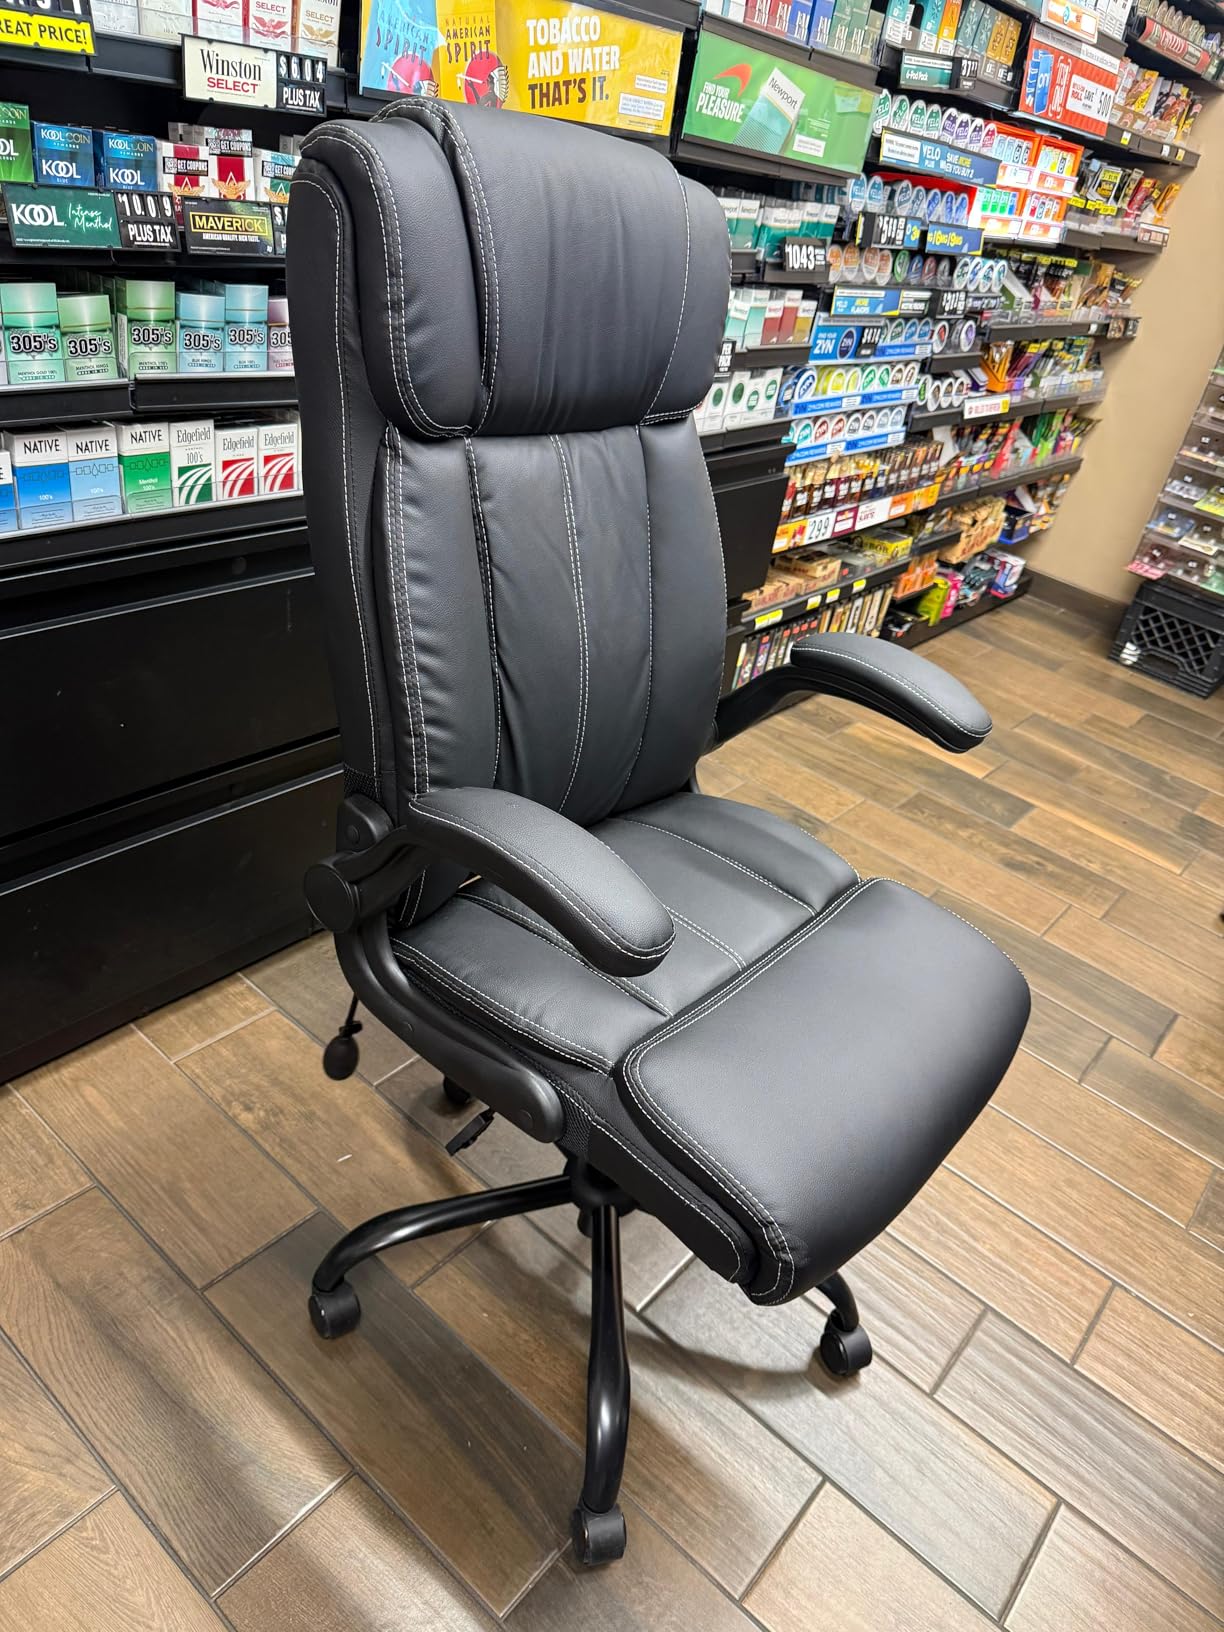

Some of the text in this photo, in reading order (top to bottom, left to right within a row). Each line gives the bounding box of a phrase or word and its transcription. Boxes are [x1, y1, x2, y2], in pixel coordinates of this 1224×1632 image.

[255, 1, 287, 14] SELECT
[305, 10, 335, 24] SELECT
[445, 15, 491, 26] NATURAL
[38, 24, 88, 45] PRICE!
[446, 25, 491, 40] AMERICAN
[526, 16, 601, 46] TOBACCO
[376, 26, 427, 66] SPIRIT
[446, 40, 491, 64] SPIRIT
[200, 49, 262, 81] Winston
[528, 45, 621, 79] AND WATER
[207, 77, 259, 94] SELECT
[528, 77, 587, 110] THAT'S
[592, 75, 609, 102] IT.
[768, 77, 798, 110] Newport
[283, 87, 321, 108] PLUS TAX
[696, 92, 746, 124] PLEASURE
[41, 128, 91, 144] KOOL COIN
[108, 138, 131, 150] KOOL
[922, 143, 941, 160] VELO
[42, 159, 82, 179] KOOL
[110, 168, 145, 185] KOOL
[11, 203, 65, 227] KOOL
[195, 215, 264, 232] MAVERICK
[128, 223, 173, 242] PLUS TAX
[10, 332, 58, 352] 305's
[132, 327, 173, 344] 305's
[184, 333, 222, 350] 305's
[229, 328, 265, 343] 305's
[68, 336, 112, 356] 305's
[813, 339, 836, 354] ZYN
[130, 430, 163, 445] NATIVE
[177, 427, 211, 444] Edgefield
[223, 436, 255, 452] Edgefield
[264, 432, 295, 447] Edgefield
[24, 439, 60, 455] NATIVE
[76, 439, 110, 455] NATIVE
